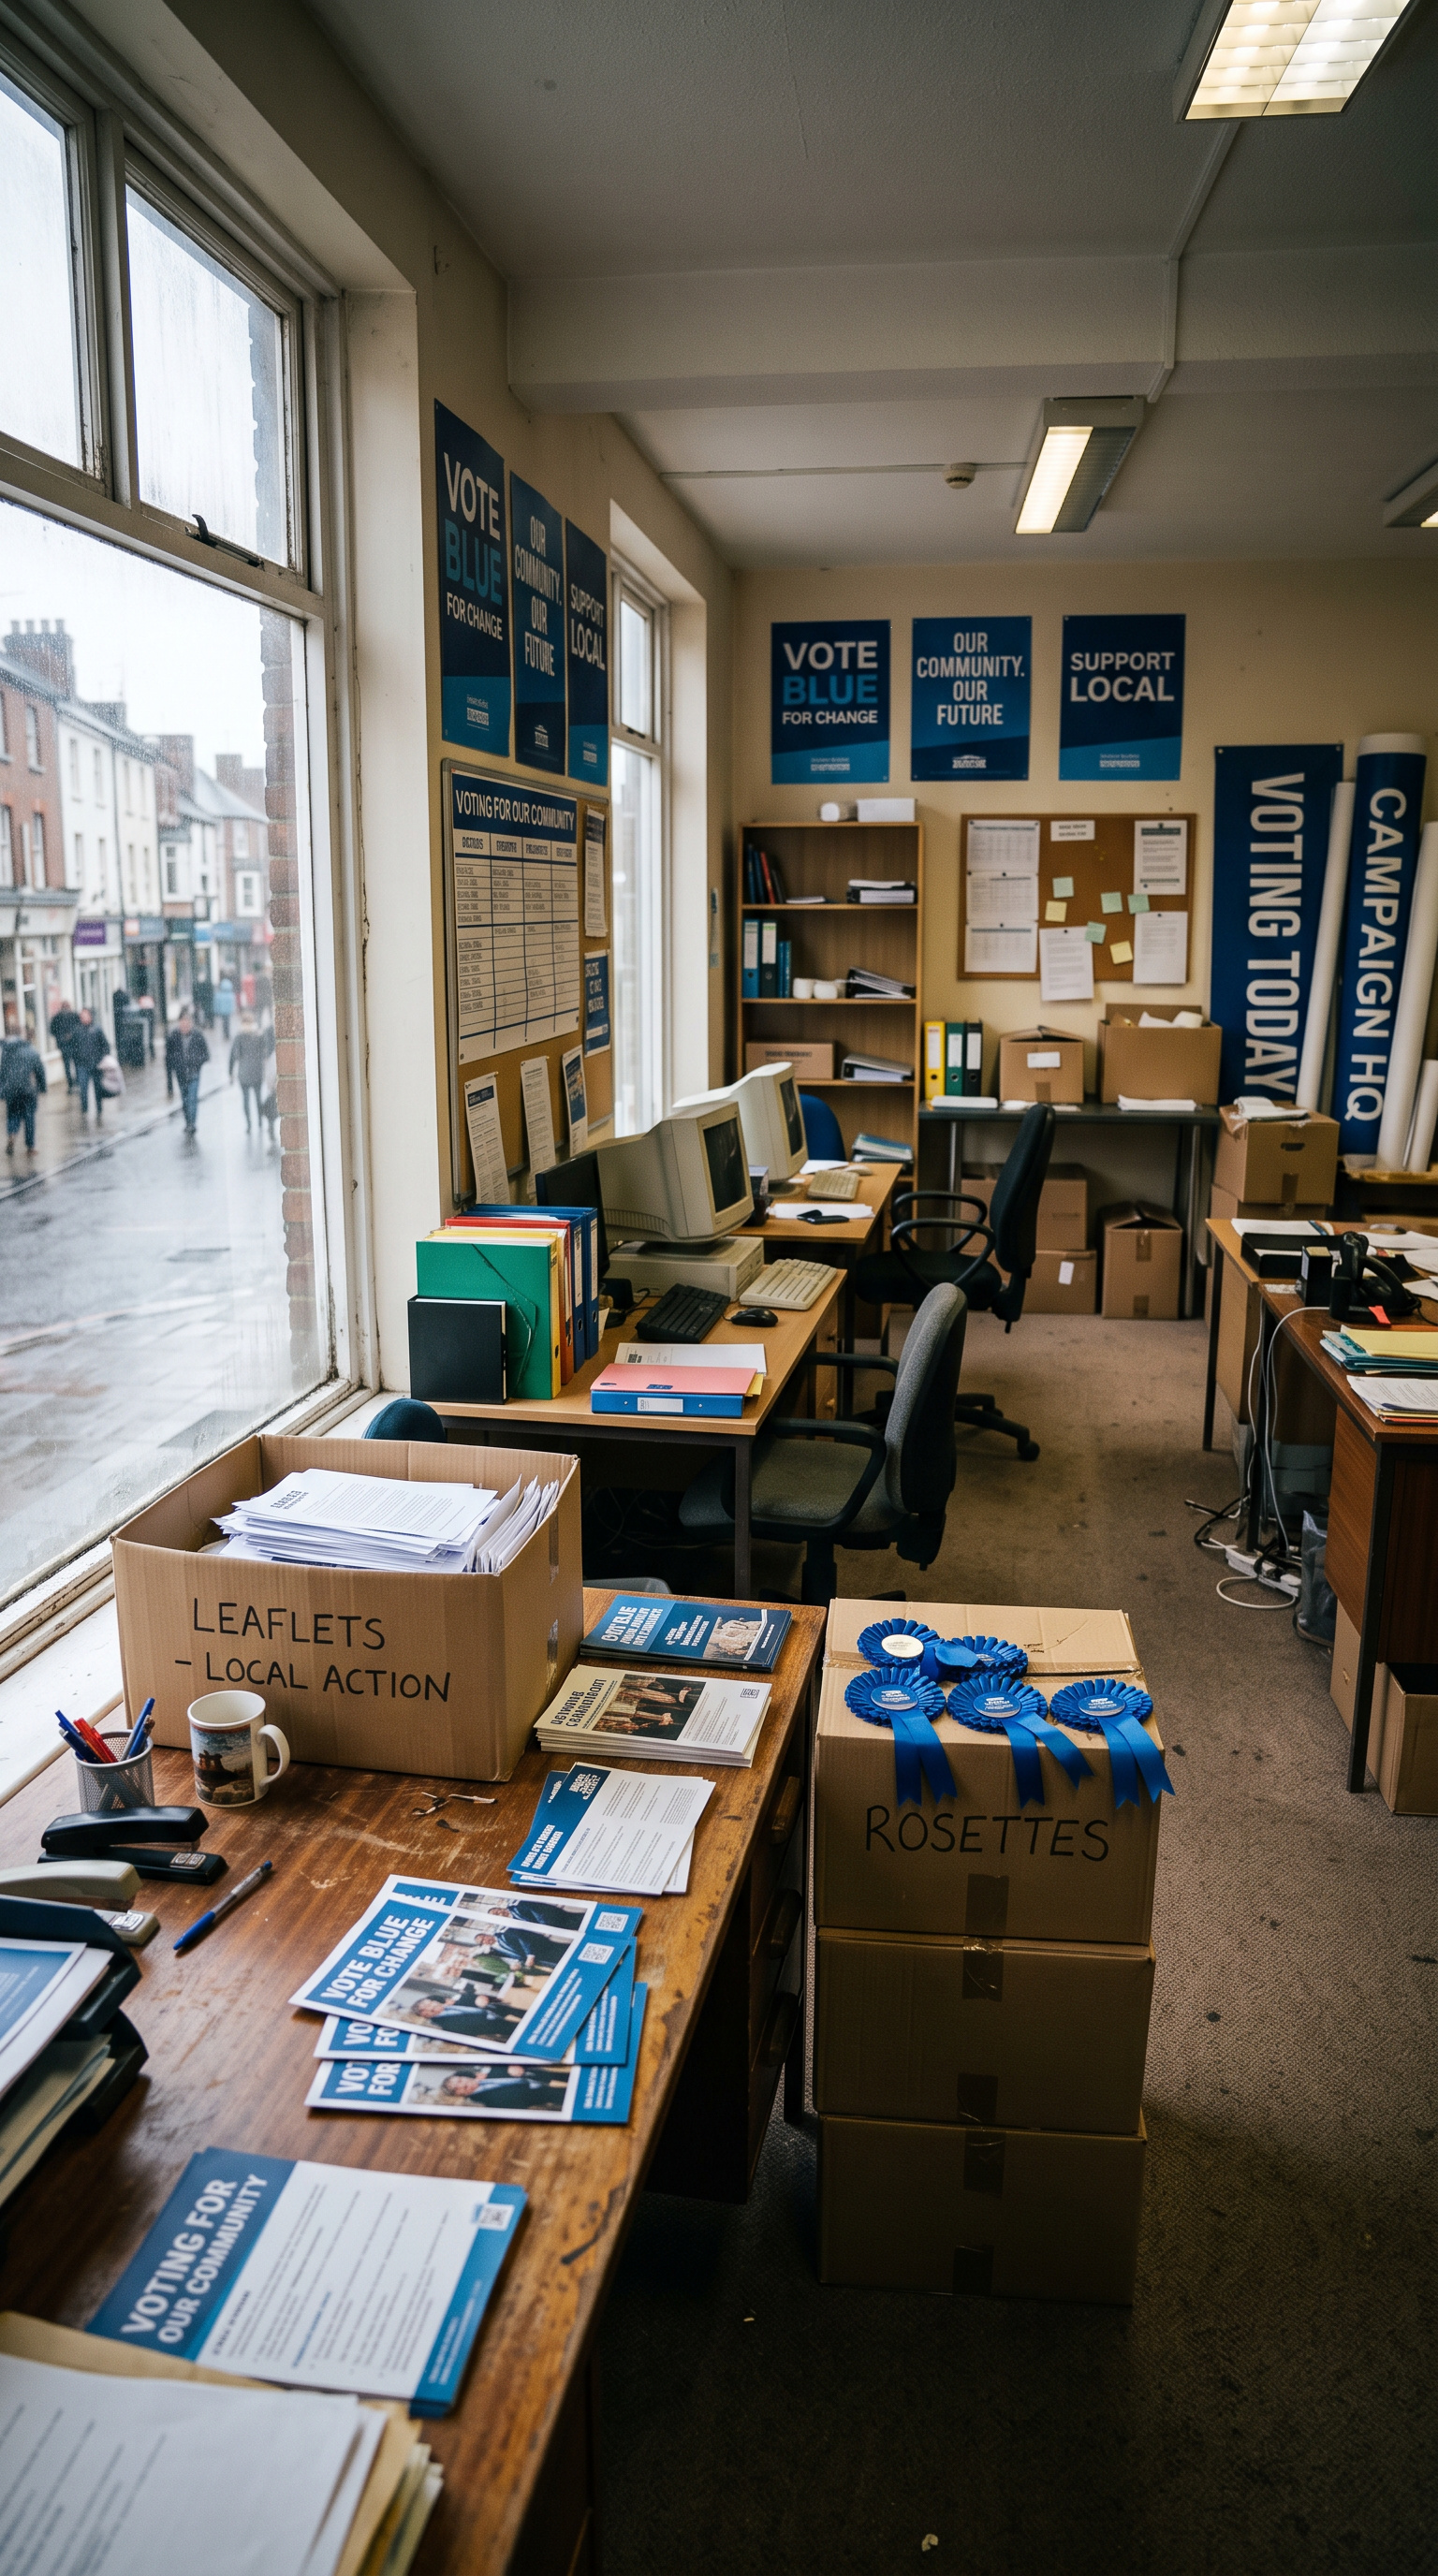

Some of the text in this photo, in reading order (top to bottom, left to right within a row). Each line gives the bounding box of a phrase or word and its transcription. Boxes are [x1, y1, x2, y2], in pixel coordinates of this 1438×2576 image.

[443, 451, 501, 541] VOTE
[529, 515, 546, 558] OUR
[444, 518, 503, 606] BLUE
[447, 591, 504, 641] FOR CHANGE
[530, 595, 548, 636] OUR
[570, 582, 605, 629] SUPPORT
[524, 630, 555, 677] FUTURE
[570, 626, 606, 671] LOCAL
[783, 640, 878, 670] VOTE
[953, 632, 989, 653] OUR
[1070, 651, 1175, 671] SUPPORT
[917, 655, 1025, 679] COMMUNITY.
[1070, 675, 1175, 702] LOCAL
[782, 674, 878, 706] BLUE
[952, 680, 989, 702] OUR
[782, 710, 878, 724] FOR CHANGE
[936, 704, 1004, 725] FUTURE
[455, 789, 575, 831] VOTING FOR OUR COMMUNITY
[1243, 772, 1305, 1094] VOTING TODAY
[1343, 787, 1408, 1122] CAMPAIGN HQ
[193, 1598, 386, 1650] LEAFLETS
[206, 1651, 309, 1690] LOCAL
[323, 1664, 451, 1703] ACTION
[866, 1804, 1109, 1862] ROSETTES
[320, 1914, 410, 1999] VOTE BLUE
[345, 1978, 388, 2009] FOR
[374, 1917, 435, 1978] CHANGE
[343, 2020, 374, 2045] VO
[374, 2027, 401, 2047] FO
[121, 2232, 201, 2335] VOTING
[186, 2178, 238, 2230] FOR
[157, 2297, 200, 2345] OUR
[185, 2174, 269, 2294] COMMUNITY
